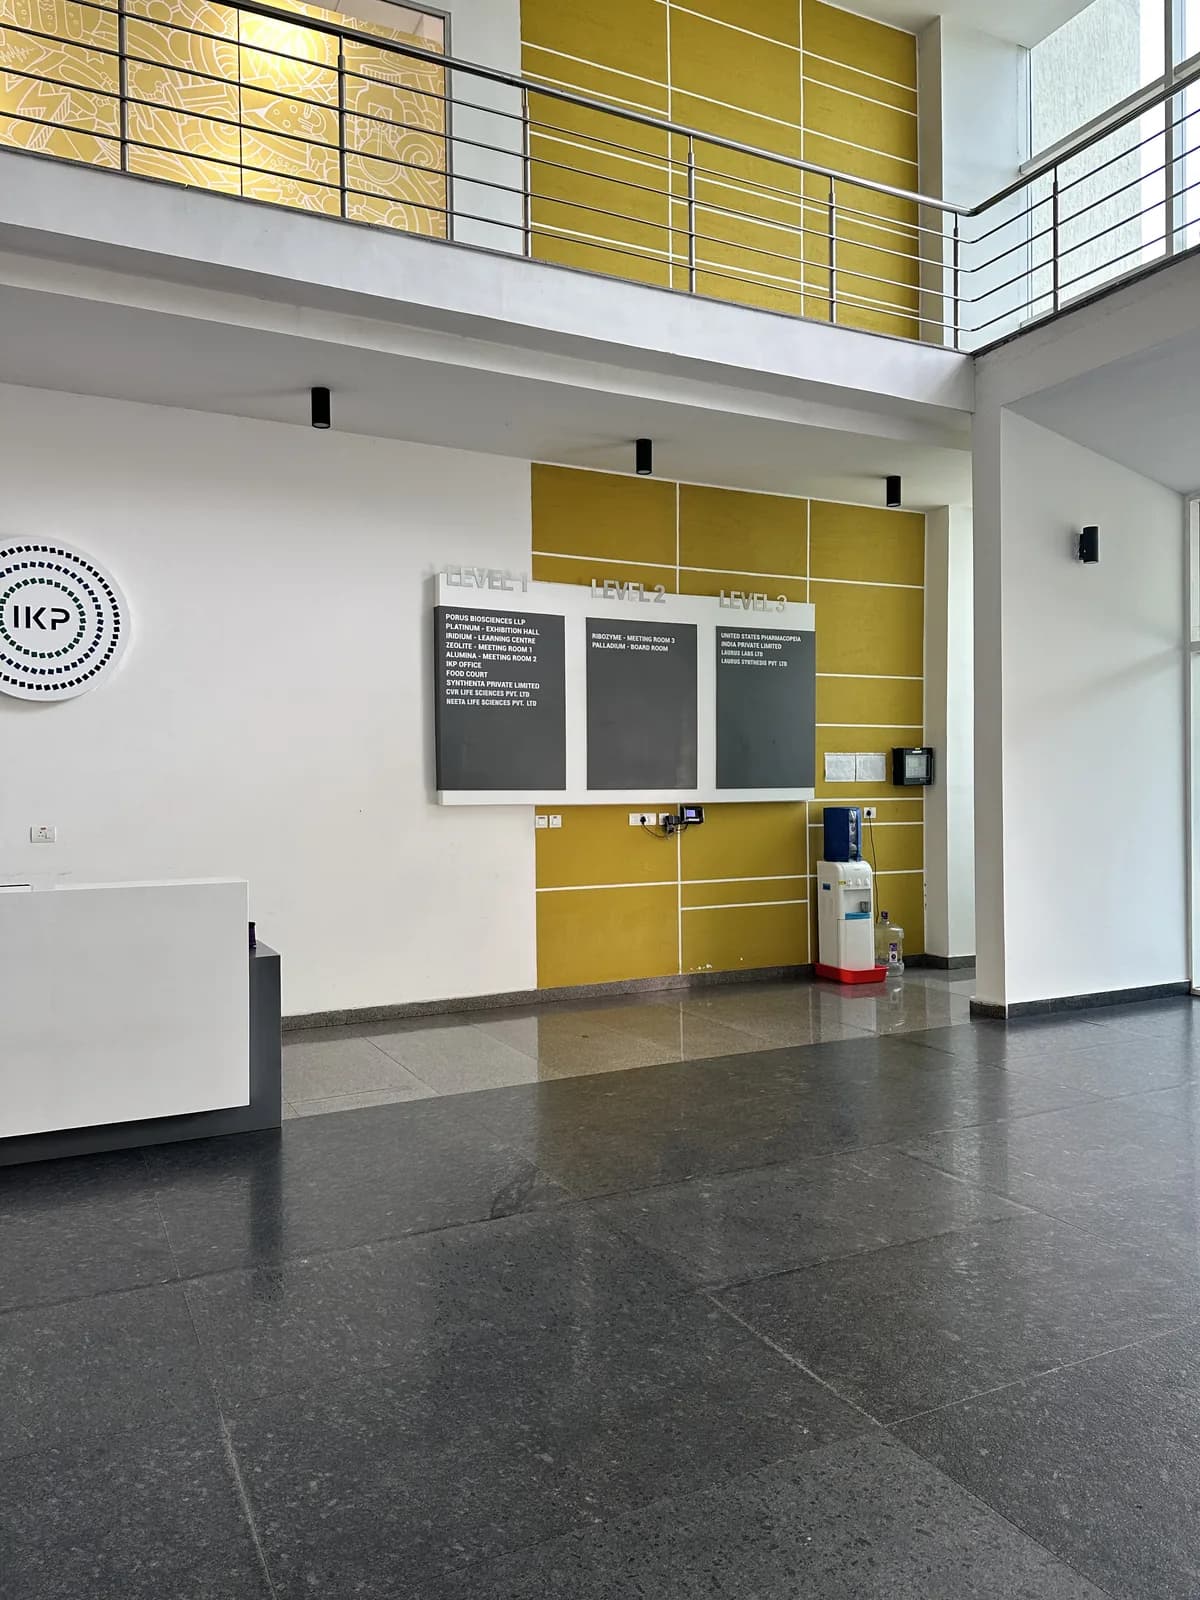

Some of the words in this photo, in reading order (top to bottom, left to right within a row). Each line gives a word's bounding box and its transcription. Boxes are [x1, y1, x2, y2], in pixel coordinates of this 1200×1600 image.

[446, 567, 513, 591] LEVEL
[592, 578, 650, 602] LEVEL
[654, 584, 666, 603] 2
[720, 590, 772, 612] LEVEL
[776, 594, 787, 613] 3
[14, 605, 70, 630] IKP
[446, 623, 480, 631] PLATINUM
[486, 626, 522, 634] EXHIBITION
[470, 616, 512, 624] BIOSCIENCES
[478, 634, 510, 642] LEARNING
